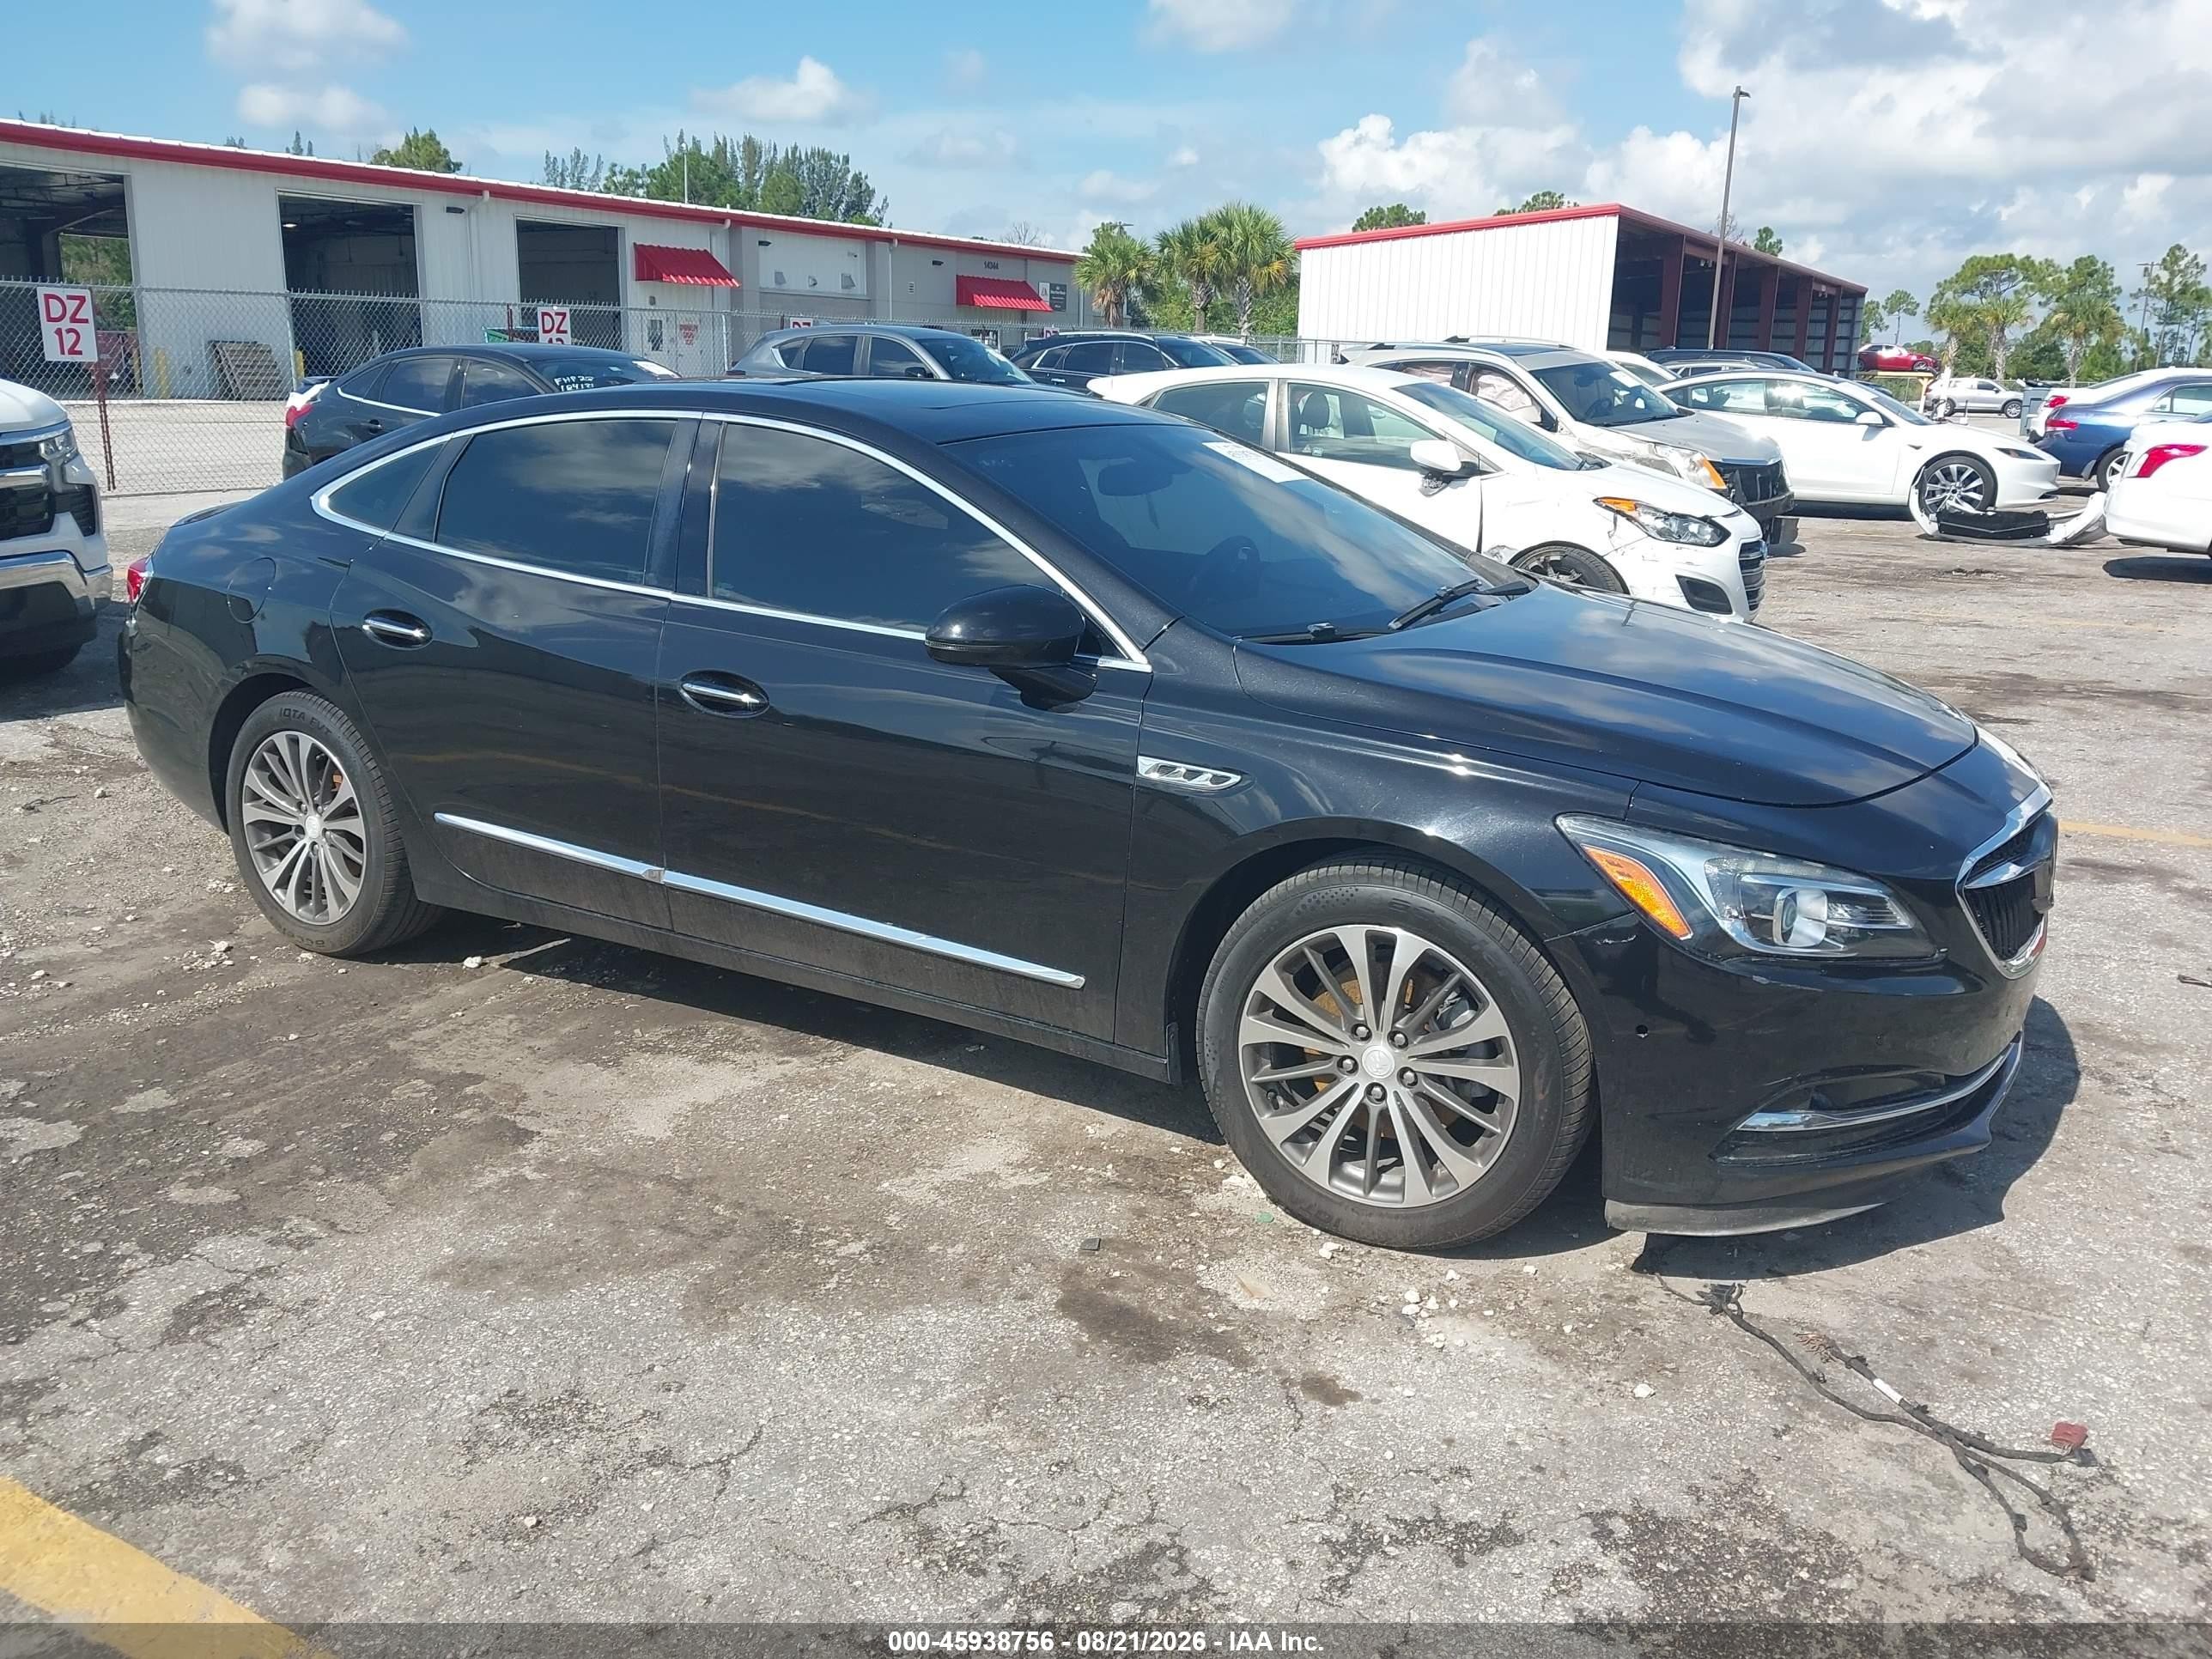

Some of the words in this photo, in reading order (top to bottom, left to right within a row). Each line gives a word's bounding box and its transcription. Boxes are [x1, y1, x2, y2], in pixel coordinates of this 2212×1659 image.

[43, 293, 90, 325] DZ
[541, 311, 568, 335] DZ
[53, 327, 83, 356] 12
